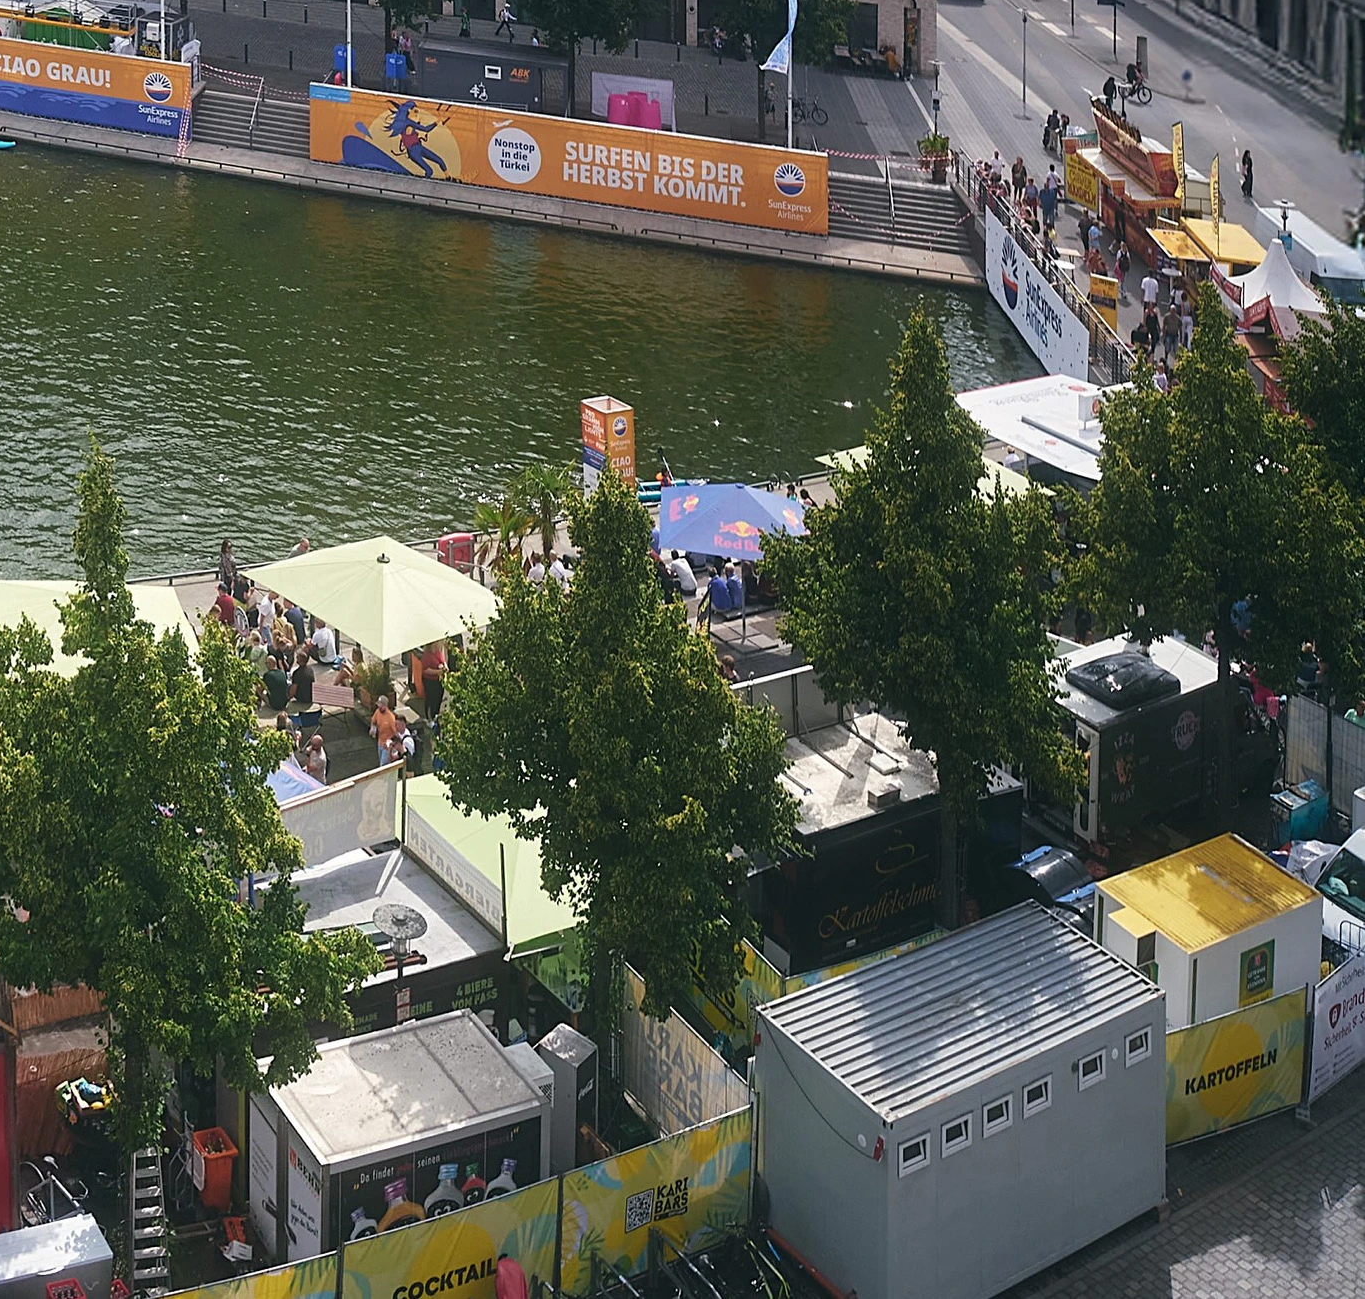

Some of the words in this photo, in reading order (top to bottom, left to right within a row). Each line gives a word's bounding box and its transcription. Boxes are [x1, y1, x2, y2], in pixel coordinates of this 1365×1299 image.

[46, 60, 112, 89] GRAU!
[510, 68, 531, 78] ABK
[137, 104, 179, 121] SunExpress
[146, 113, 173, 127] Airlines
[494, 137, 536, 153] Nonstop
[501, 149, 511, 159] in
[513, 151, 529, 162] die
[499, 158, 531, 173] Türkei
[564, 140, 651, 172] SURFEN
[657, 153, 695, 177] BIS
[701, 159, 745, 186] DER
[562, 161, 647, 193] HERBST
[653, 176, 747, 208] KOMMT.
[768, 199, 812, 215] SunExpress
[777, 210, 804, 222] Airlines
[1025, 270, 1063, 339] SunExpress
[1026, 302, 1049, 348] Airlines
[713, 534, 743, 551] Red
[456, 984, 463, 997] 4
[463, 976, 494, 995] BIERE
[410, 1000, 433, 1018] EINE
[451, 994, 473, 1010] VOM
[472, 989, 499, 1007] FASS
[1185, 1048, 1278, 1096] KARTOFFELN
[372, 1165, 395, 1180] findet
[417, 1153, 441, 1169] seinen
[656, 1176, 689, 1200] KARI
[654, 1191, 689, 1216] BARS
[391, 1253, 508, 1299] COCKTAIL
